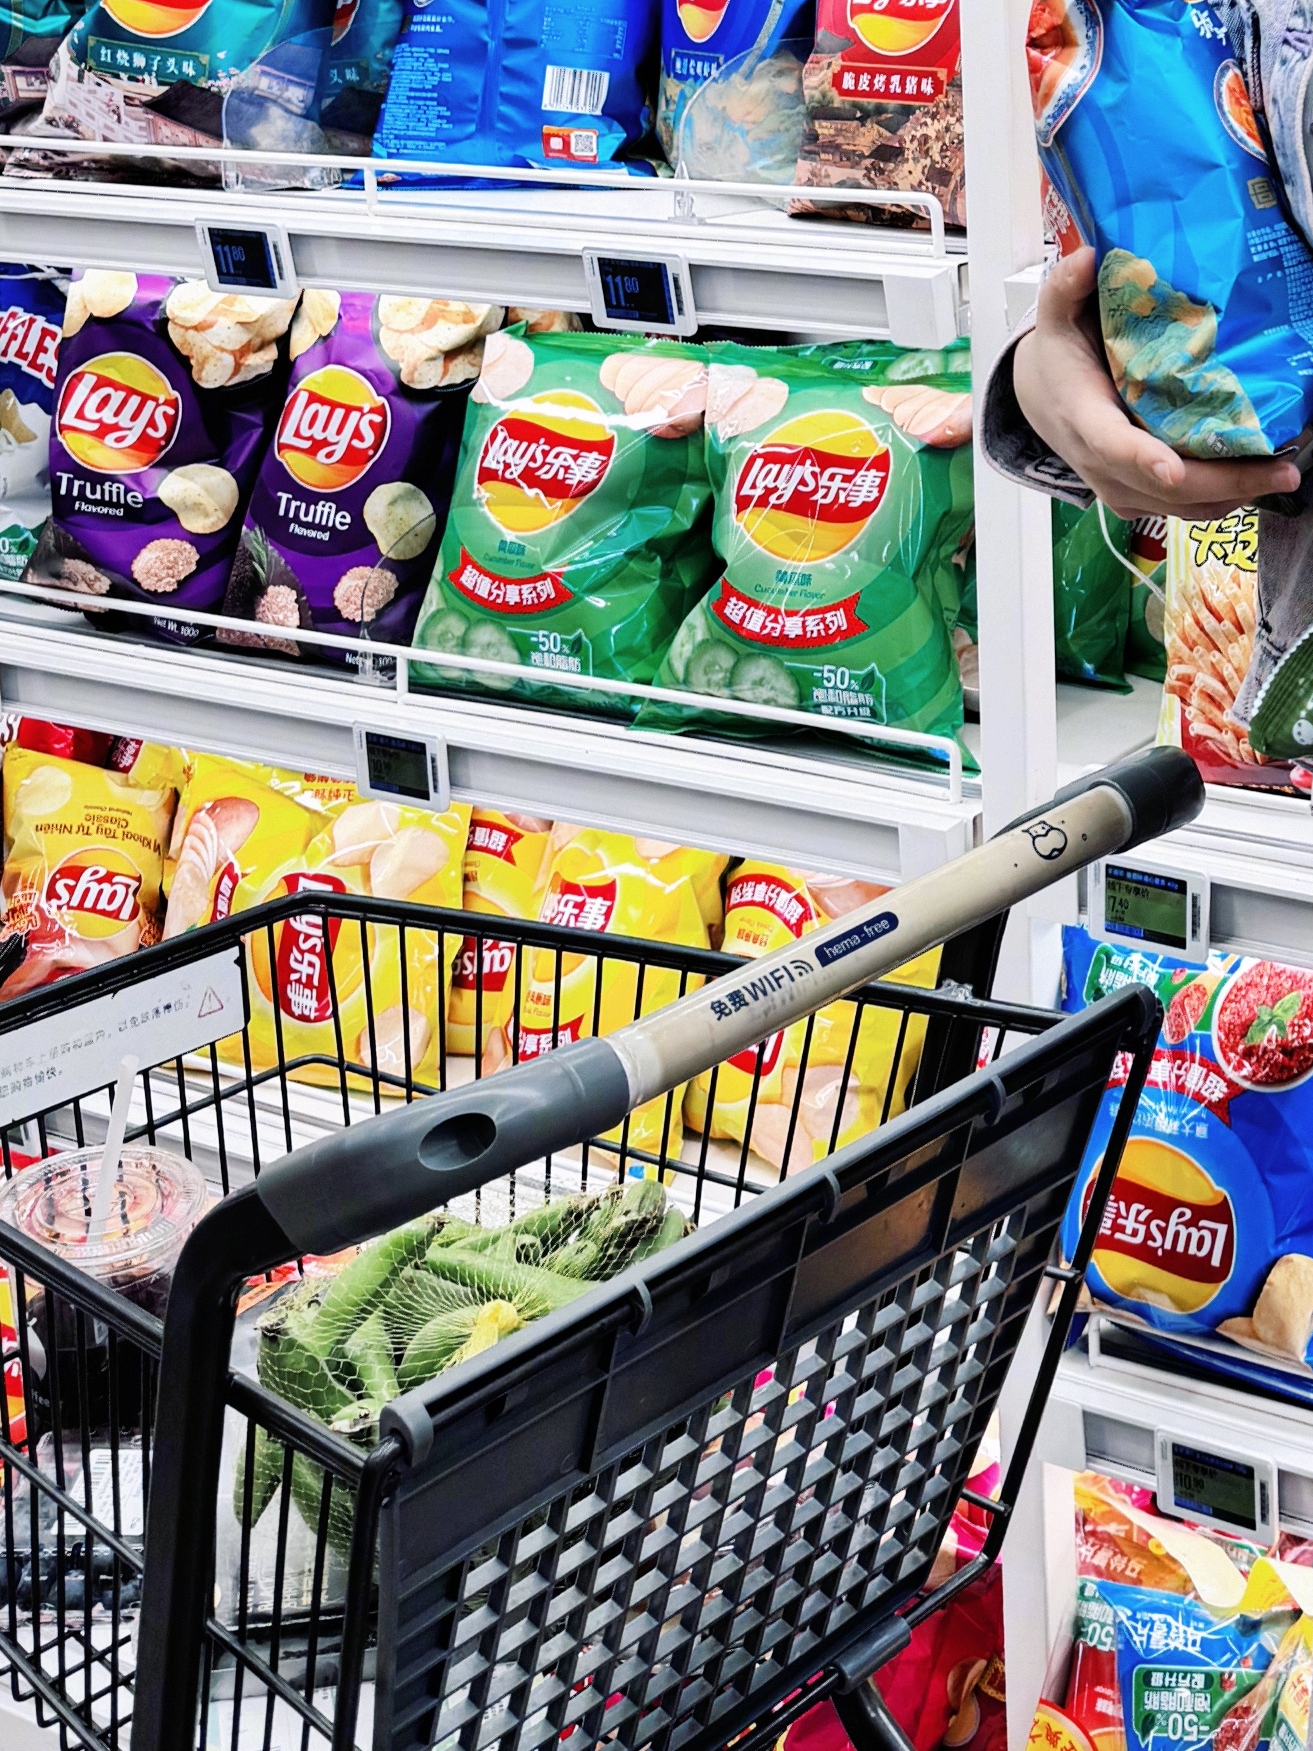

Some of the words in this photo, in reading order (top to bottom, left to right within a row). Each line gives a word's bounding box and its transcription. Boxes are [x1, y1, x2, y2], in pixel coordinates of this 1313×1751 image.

[99, 44, 198, 78] 红烧狮子头味
[842, 71, 935, 97] 脆皮烤乳猪味
[60, 371, 178, 450] Lay's
[280, 390, 377, 465] Lay's
[483, 426, 605, 486] Lay's乐事
[56, 471, 145, 510] Truffle
[739, 458, 882, 508] Lay's乐事
[74, 499, 125, 518] Flavored
[276, 491, 353, 533] Truffle
[288, 523, 330, 542] Flavored
[459, 564, 557, 609] 超值分享系列
[721, 594, 849, 641] 超值分享系列
[812, 666, 861, 692] -50%
[84, 811, 130, 829] Classic
[55, 864, 141, 921] Lay's
[729, 880, 805, 925] 超值分享系列
[709, 964, 796, 1022] 免费WIFI
